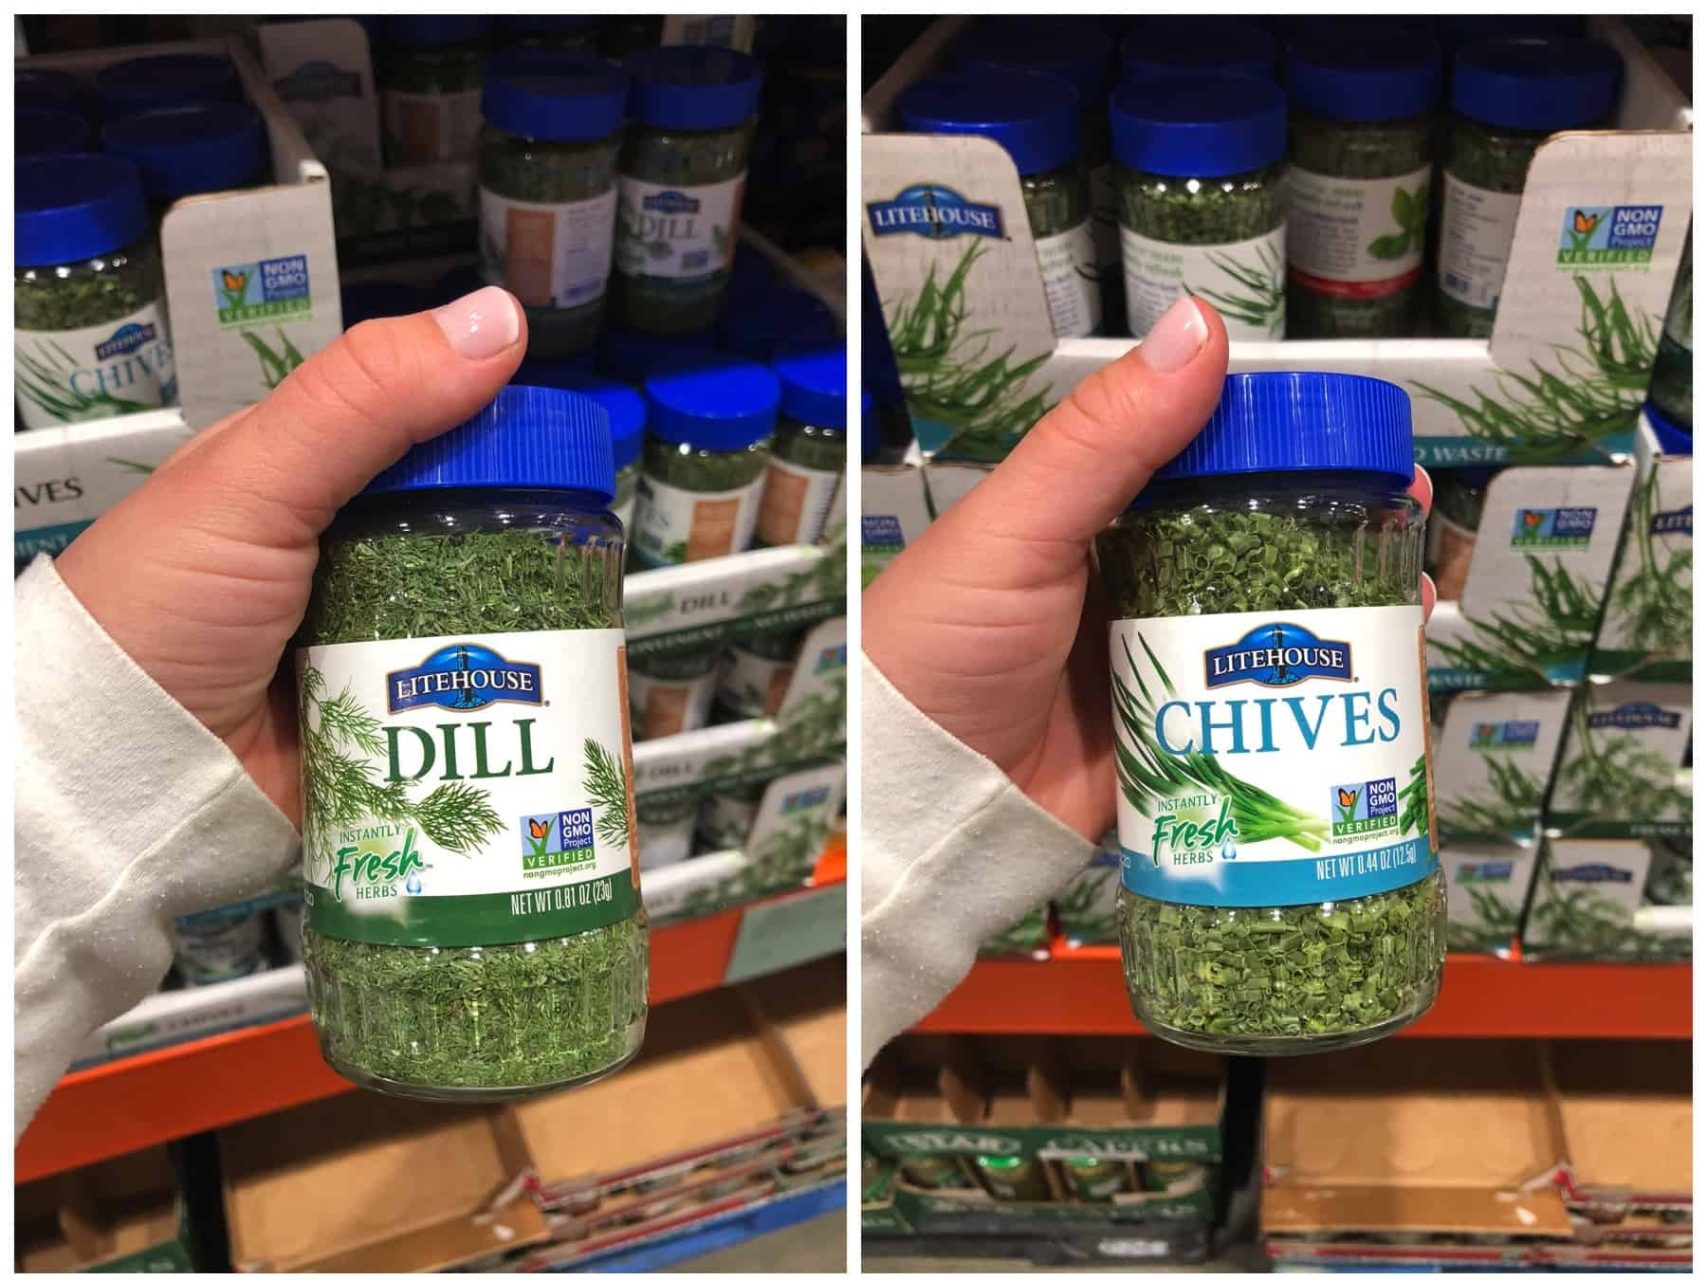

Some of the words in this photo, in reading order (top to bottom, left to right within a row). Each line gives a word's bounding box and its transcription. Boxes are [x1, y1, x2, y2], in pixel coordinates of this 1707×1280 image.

[875, 206, 996, 228] LITEHOUSE
[1617, 209, 1659, 222] NON
[1614, 223, 1656, 236] GMO
[264, 259, 304, 275] NON
[1213, 648, 1344, 675] LITEHOUSE
[397, 670, 533, 699] LITEHOUSE
[1155, 688, 1401, 756] CHIVES
[381, 718, 554, 782] DILL
[1369, 781, 1394, 795] NON
[1158, 794, 1218, 812] INSTANTLY
[1370, 793, 1395, 806] GMO
[563, 811, 590, 826] NON
[1370, 805, 1396, 816] Project
[563, 824, 591, 838] GMO
[1152, 795, 1238, 867] Fresh
[1337, 816, 1396, 834] VERIFIED
[340, 825, 401, 843] INSTANTLY
[564, 837, 592, 848] Project
[1333, 829, 1399, 845] nongmoproject.org
[334, 827, 423, 902] Fresh
[527, 849, 593, 867] VERIFIED
[1173, 851, 1214, 865] HERBS
[1316, 859, 1336, 880] NET
[1339, 856, 1355, 878] WT
[1357, 852, 1378, 875] 0.44
[1380, 849, 1392, 870] OZ
[1393, 842, 1417, 869] (12.5g)
[523, 862, 597, 879] nongmoproject.org
[356, 886, 398, 900] HERBS
[511, 893, 532, 916] NET
[535, 890, 551, 913] WT
[555, 887, 576, 910] 0.81
[579, 884, 591, 905] OZ
[593, 878, 613, 905] (23g)
